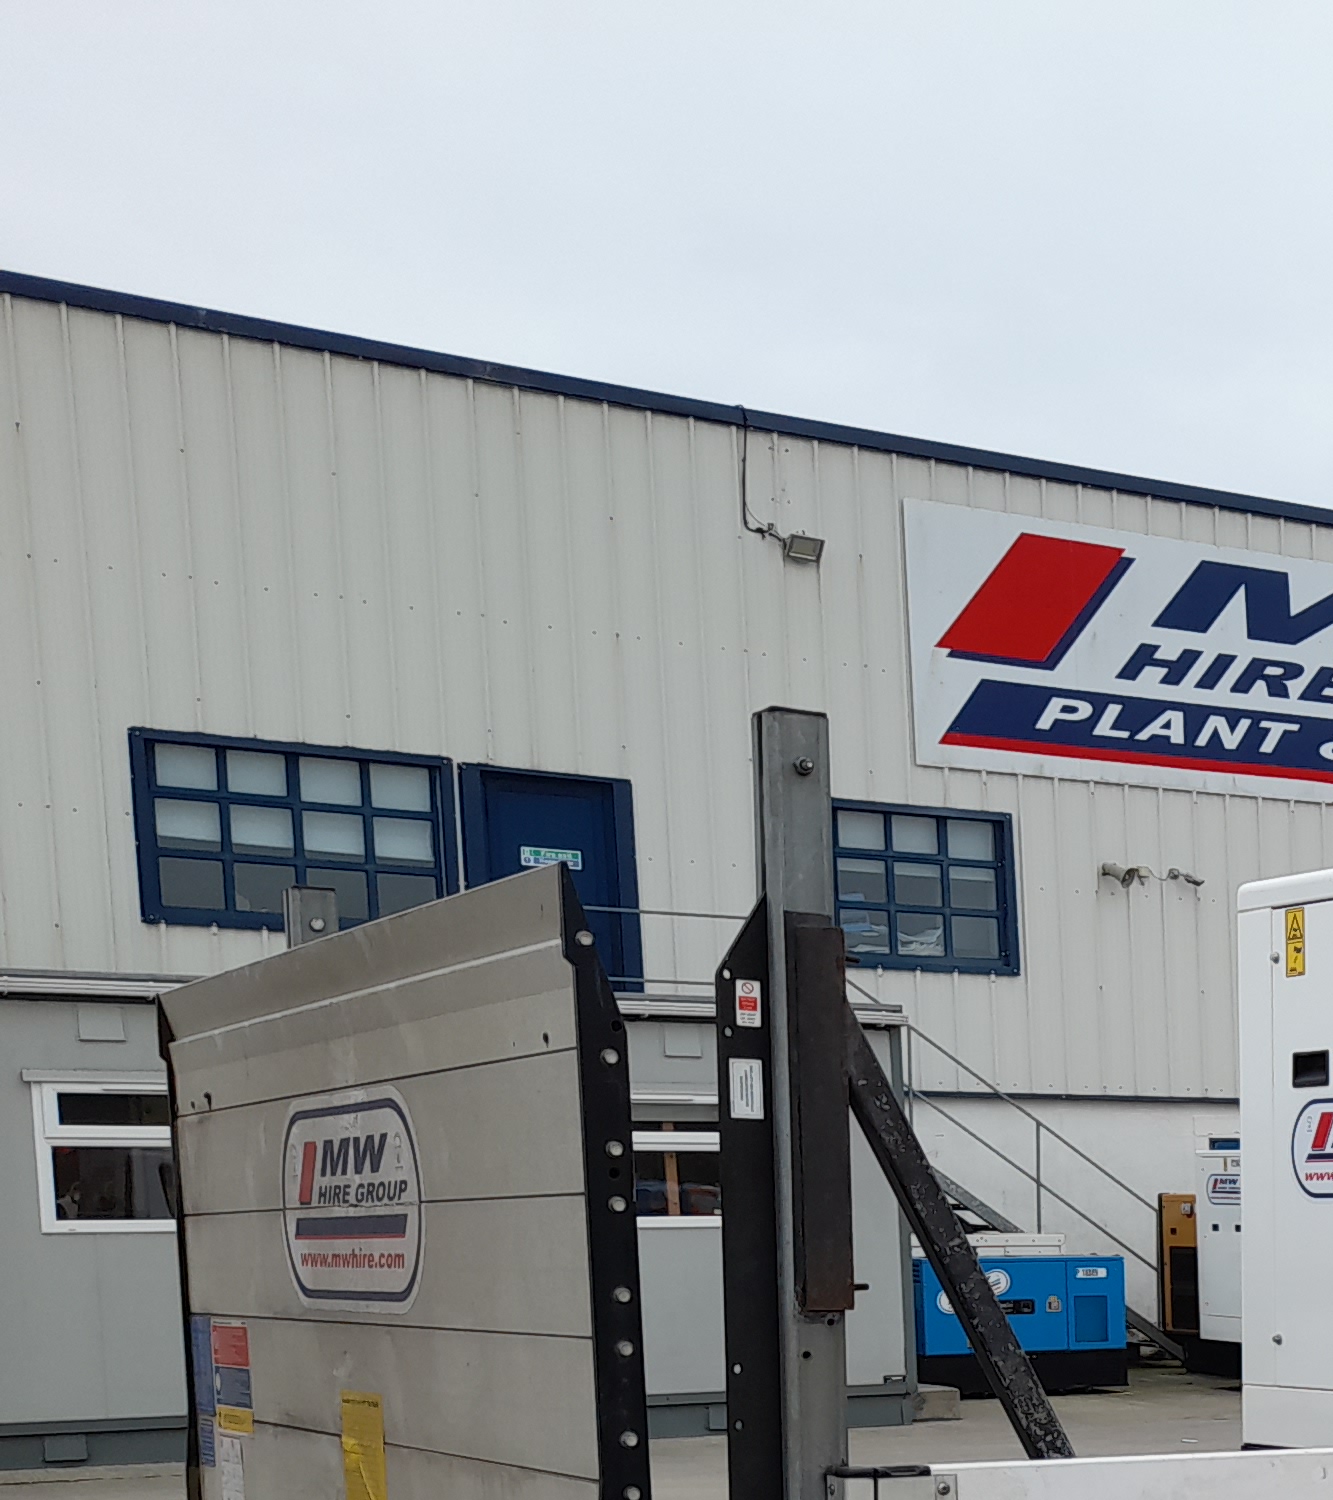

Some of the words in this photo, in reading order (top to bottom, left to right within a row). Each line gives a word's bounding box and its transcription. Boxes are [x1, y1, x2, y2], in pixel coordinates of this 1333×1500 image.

[1034, 696, 1300, 755] PLANT
[320, 1131, 388, 1178] MW
[317, 1184, 351, 1205] HIRE
[354, 1179, 408, 1203] GROUP
[301, 1247, 405, 1269] www.mwhire.com
